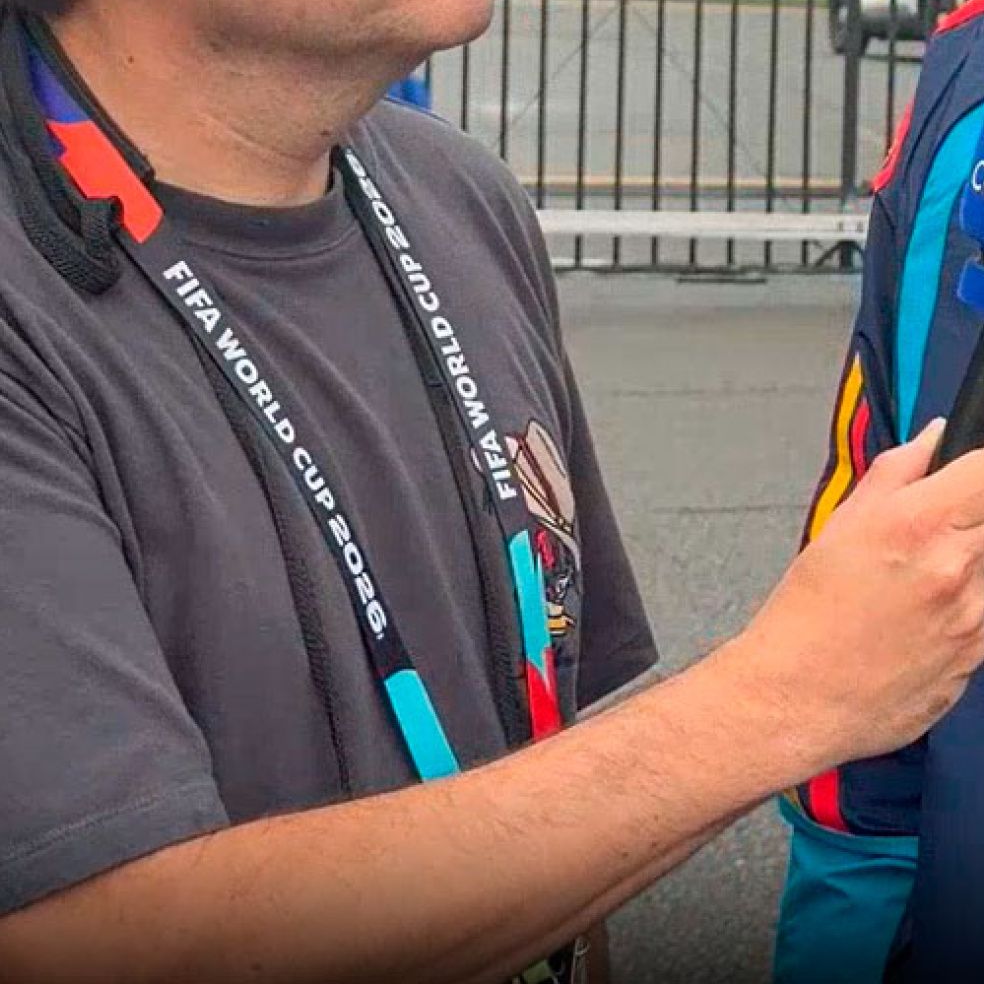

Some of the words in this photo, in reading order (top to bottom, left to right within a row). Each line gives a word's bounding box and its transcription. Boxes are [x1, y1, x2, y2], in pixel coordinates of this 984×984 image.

[399, 252, 441, 313] CUP
[430, 315, 490, 429] WORLD
[162, 260, 222, 334] FIFA
[214, 327, 296, 444] WORLD
[292, 446, 336, 511] CUP
[327, 513, 388, 636] 2026
[478, 429, 518, 501] FIFA
